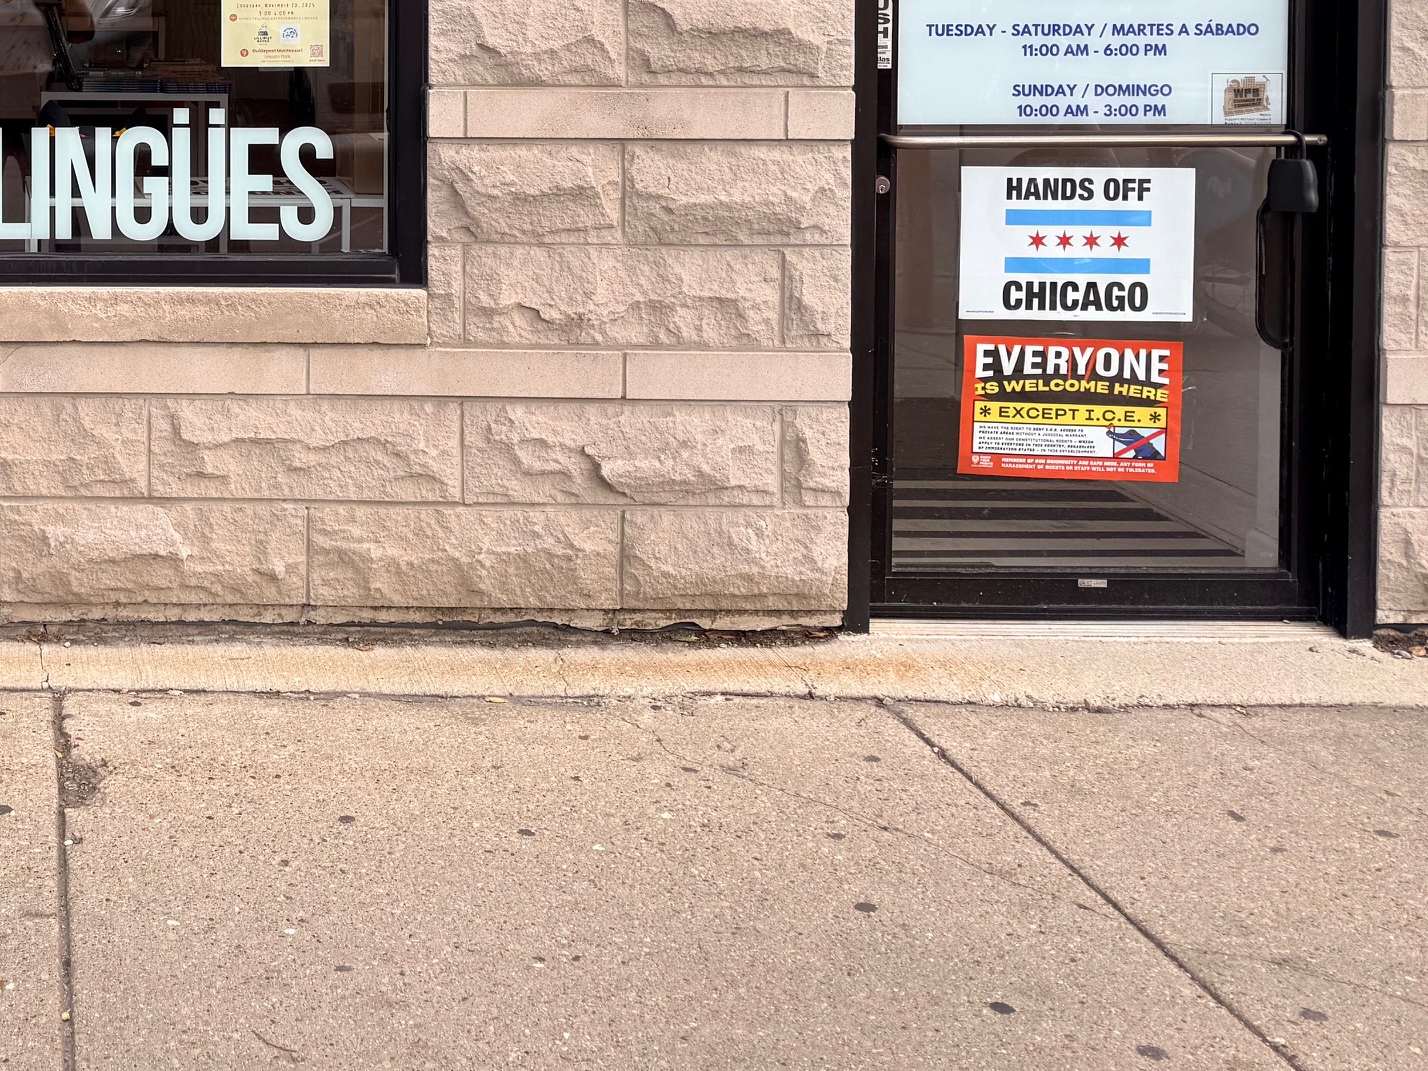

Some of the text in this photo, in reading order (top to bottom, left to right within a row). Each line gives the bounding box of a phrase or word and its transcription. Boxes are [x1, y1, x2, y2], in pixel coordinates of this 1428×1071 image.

[926, 18, 1260, 39] TUESDAY SATURDAY / MARTES A SÁBADO
[1021, 43, 1168, 58] 11:00 AM 6:00 PM
[1012, 83, 1172, 99] SUNDAY / DOMINGO
[1016, 103, 1167, 118] 10:00 AM 3:00 PM
[1005, 177, 1152, 202] HANDS OFF
[1001, 280, 1149, 313] CHICAGO
[974, 343, 1171, 385] EVERYONE
[974, 378, 1170, 403] IS WELCOME HERE
[998, 406, 1142, 424] EXCEPT I.C.E.
